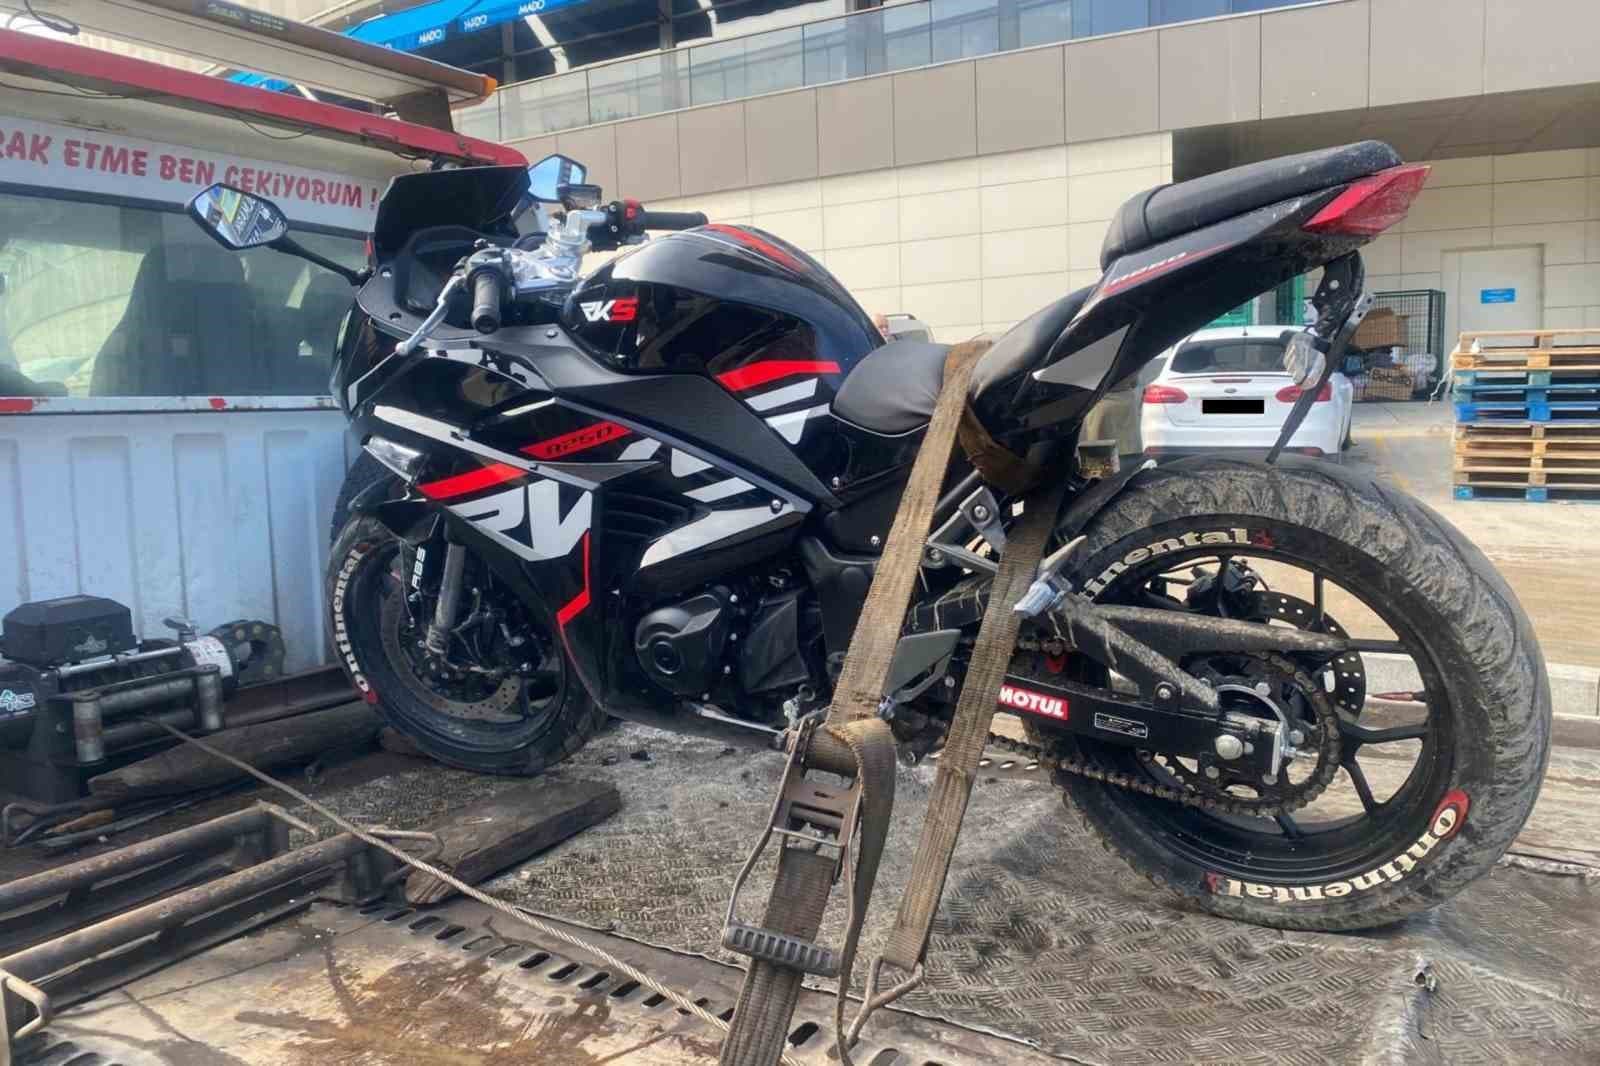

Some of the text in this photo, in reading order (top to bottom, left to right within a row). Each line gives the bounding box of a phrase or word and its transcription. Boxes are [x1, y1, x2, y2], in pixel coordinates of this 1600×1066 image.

[64, 138, 148, 176] ETME
[160, 154, 216, 185] BEN
[580, 298, 637, 321] RKS
[411, 546, 427, 590] ABS
[1000, 686, 1064, 717] MOTUL
